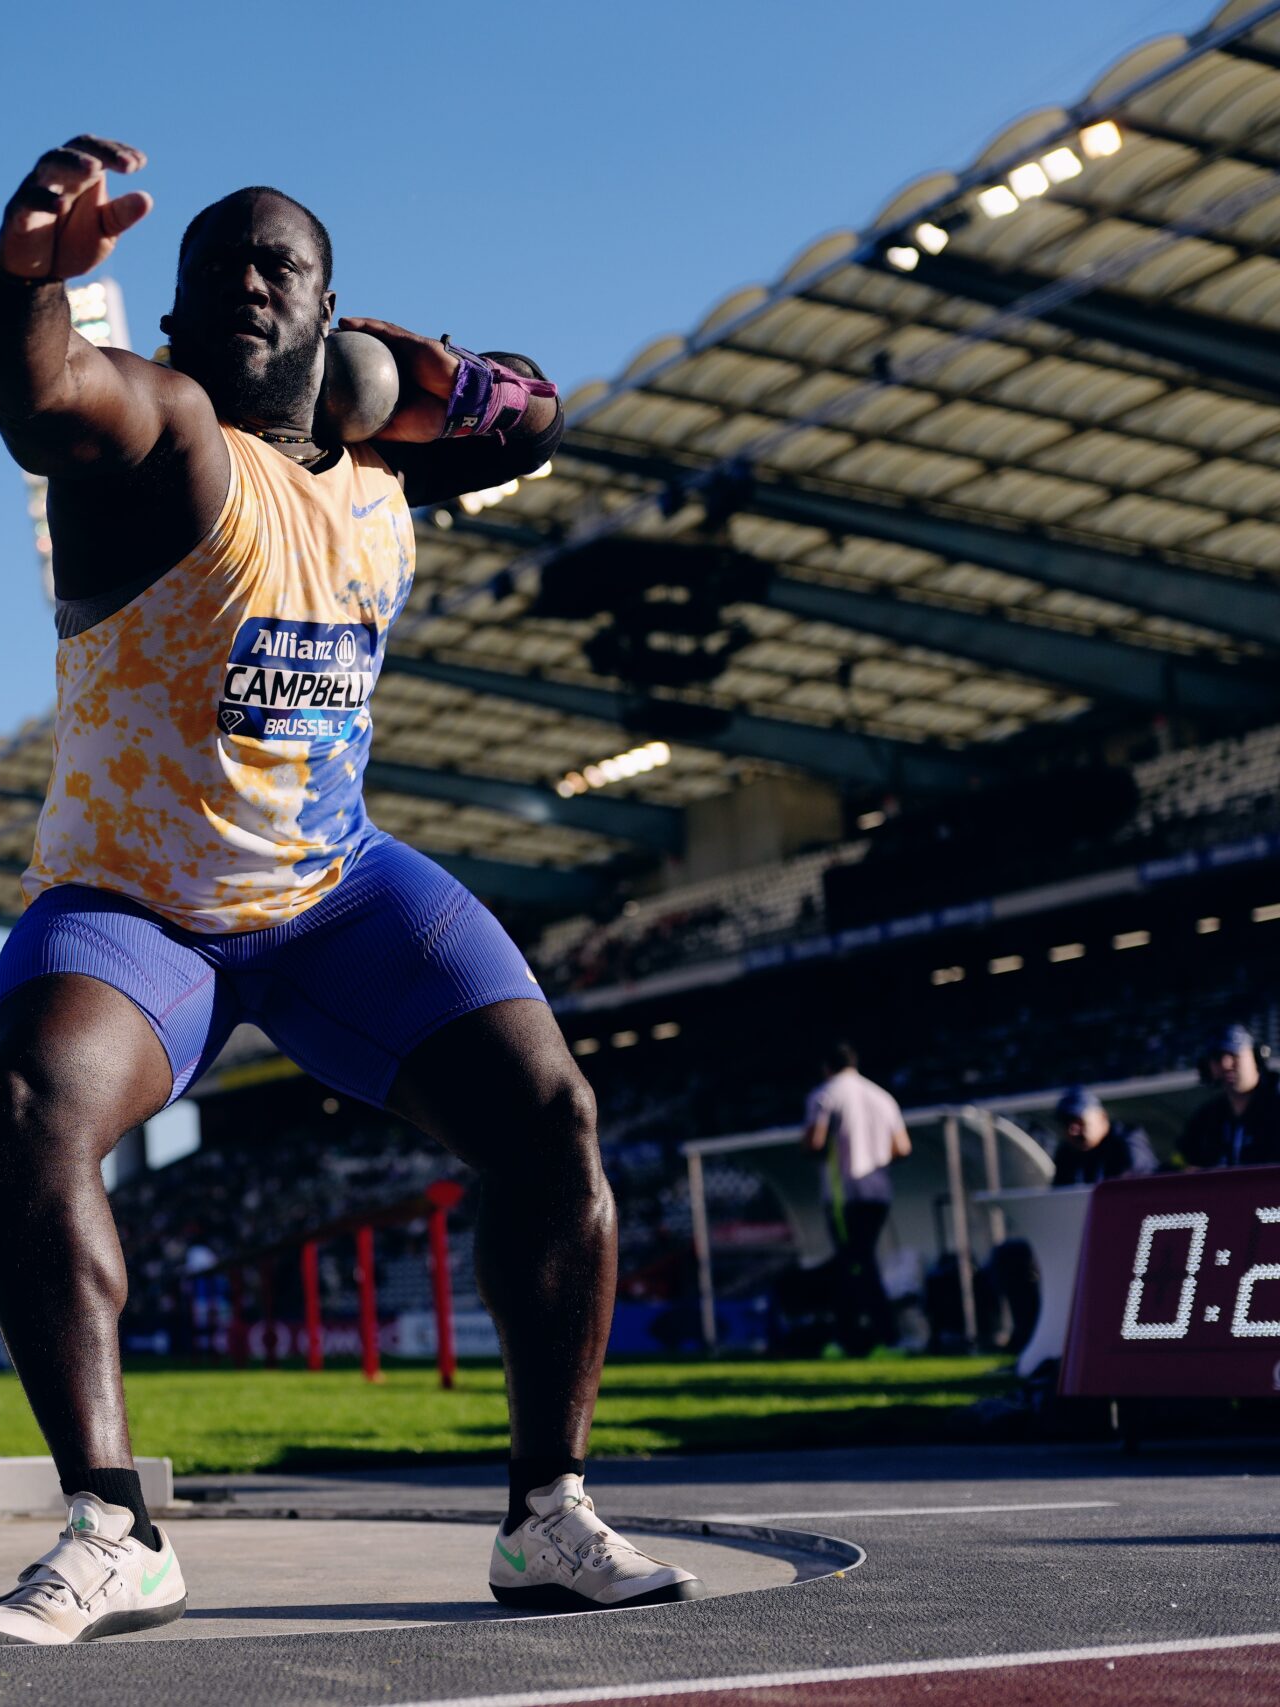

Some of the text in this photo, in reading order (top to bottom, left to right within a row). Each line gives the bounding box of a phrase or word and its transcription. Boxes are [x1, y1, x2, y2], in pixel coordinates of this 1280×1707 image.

[251, 628, 334, 661] Allianz
[224, 666, 365, 709] CAMPBELL
[263, 718, 346, 737] BRUSSELS
